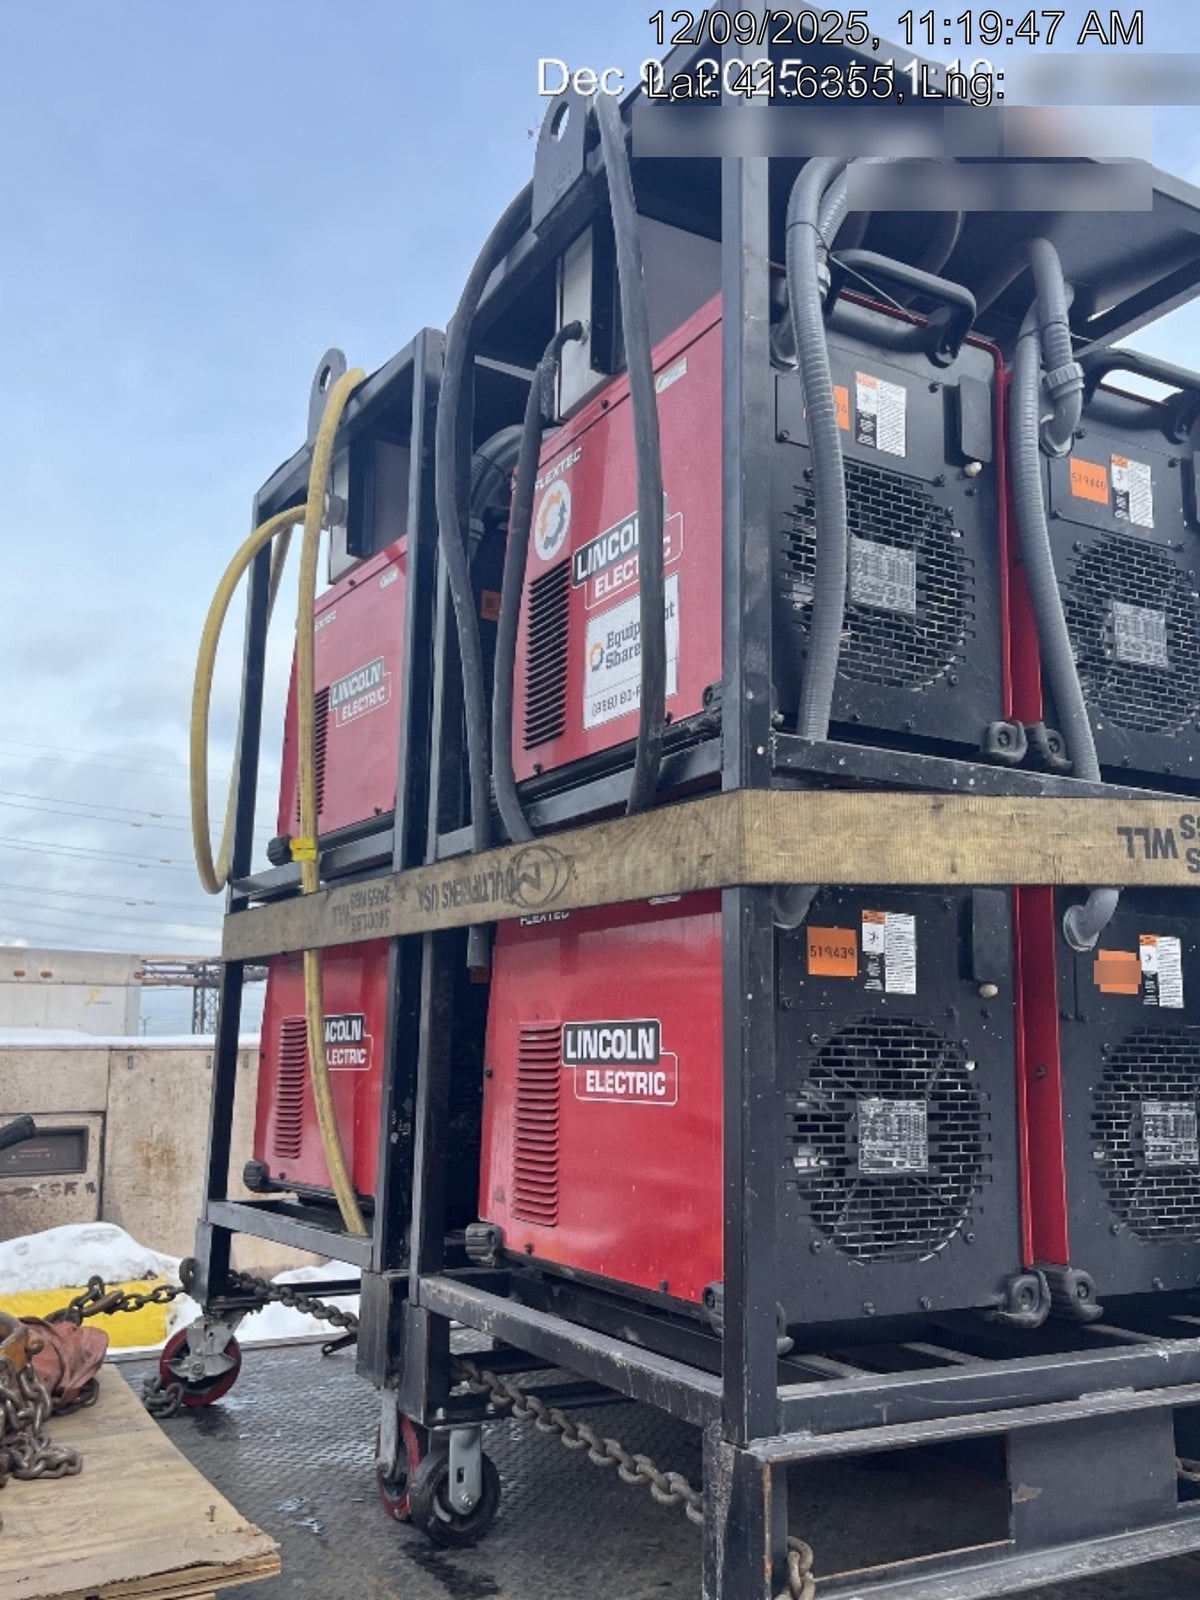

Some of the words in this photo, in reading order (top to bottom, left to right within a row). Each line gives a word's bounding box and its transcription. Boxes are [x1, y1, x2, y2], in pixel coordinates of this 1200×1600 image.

[577, 518, 640, 581] LINCO
[595, 535, 672, 598] ELECTC
[605, 643, 641, 670] Share
[331, 662, 382, 707] LINCOLN
[341, 686, 385, 721] ELECTRIC
[1116, 827, 1179, 859] WLL
[810, 945, 855, 959] 519439
[324, 1018, 362, 1043] NCOLN
[566, 1027, 655, 1059] LINCOLN
[326, 1049, 367, 1066] LECTRIC
[586, 1069, 666, 1096] ELECTRIC
